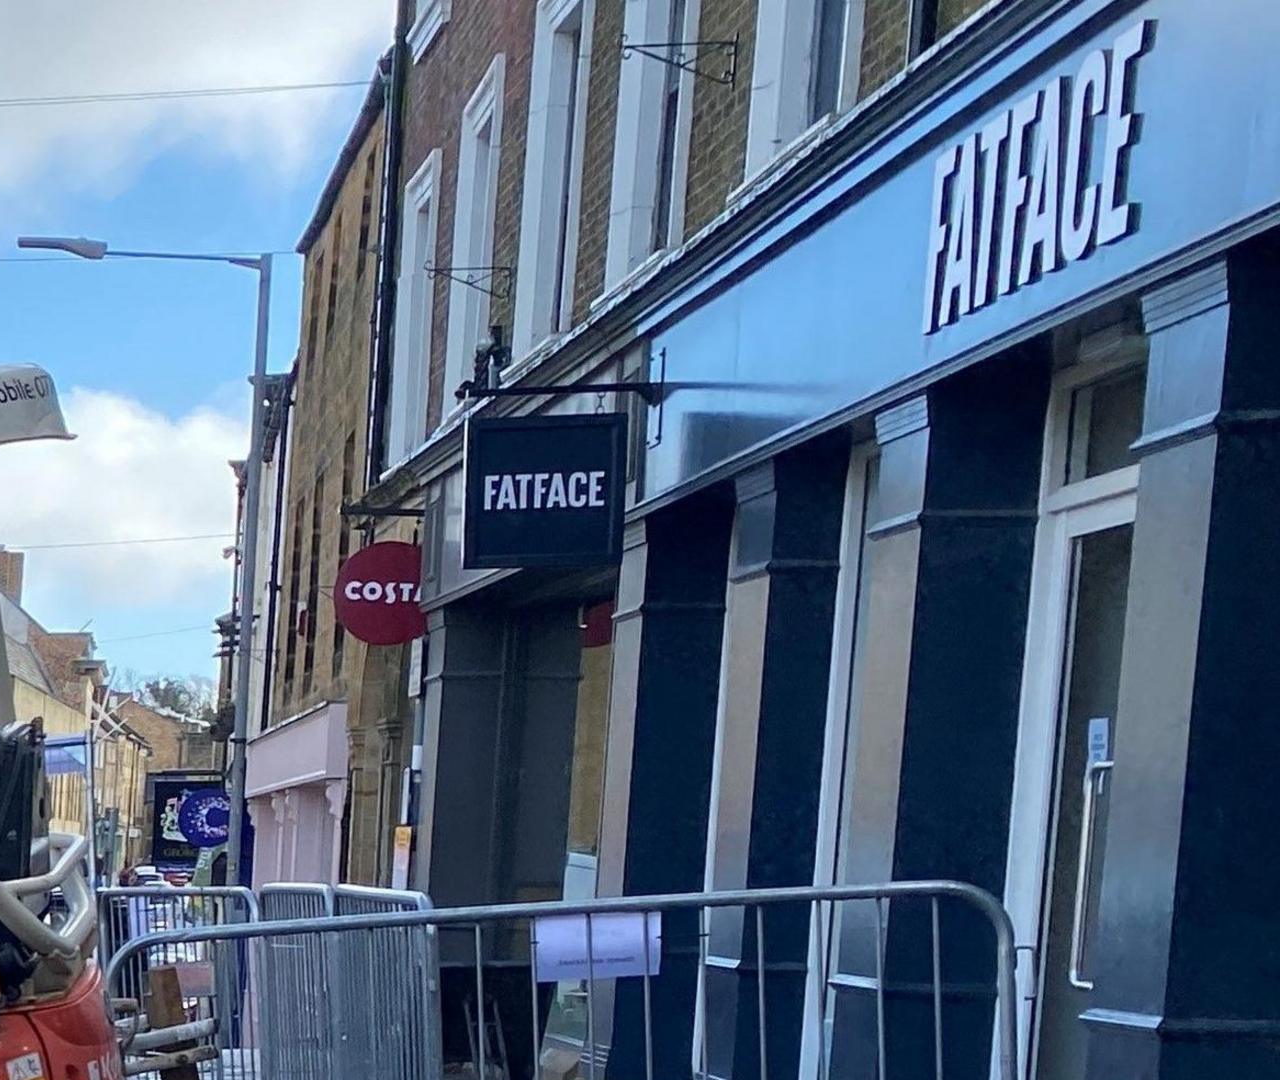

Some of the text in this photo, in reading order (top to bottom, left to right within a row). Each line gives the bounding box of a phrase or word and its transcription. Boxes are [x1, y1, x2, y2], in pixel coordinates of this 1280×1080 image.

[923, 19, 1150, 335] FATFACE
[484, 470, 605, 510] FATFACE
[344, 580, 422, 605] COST
